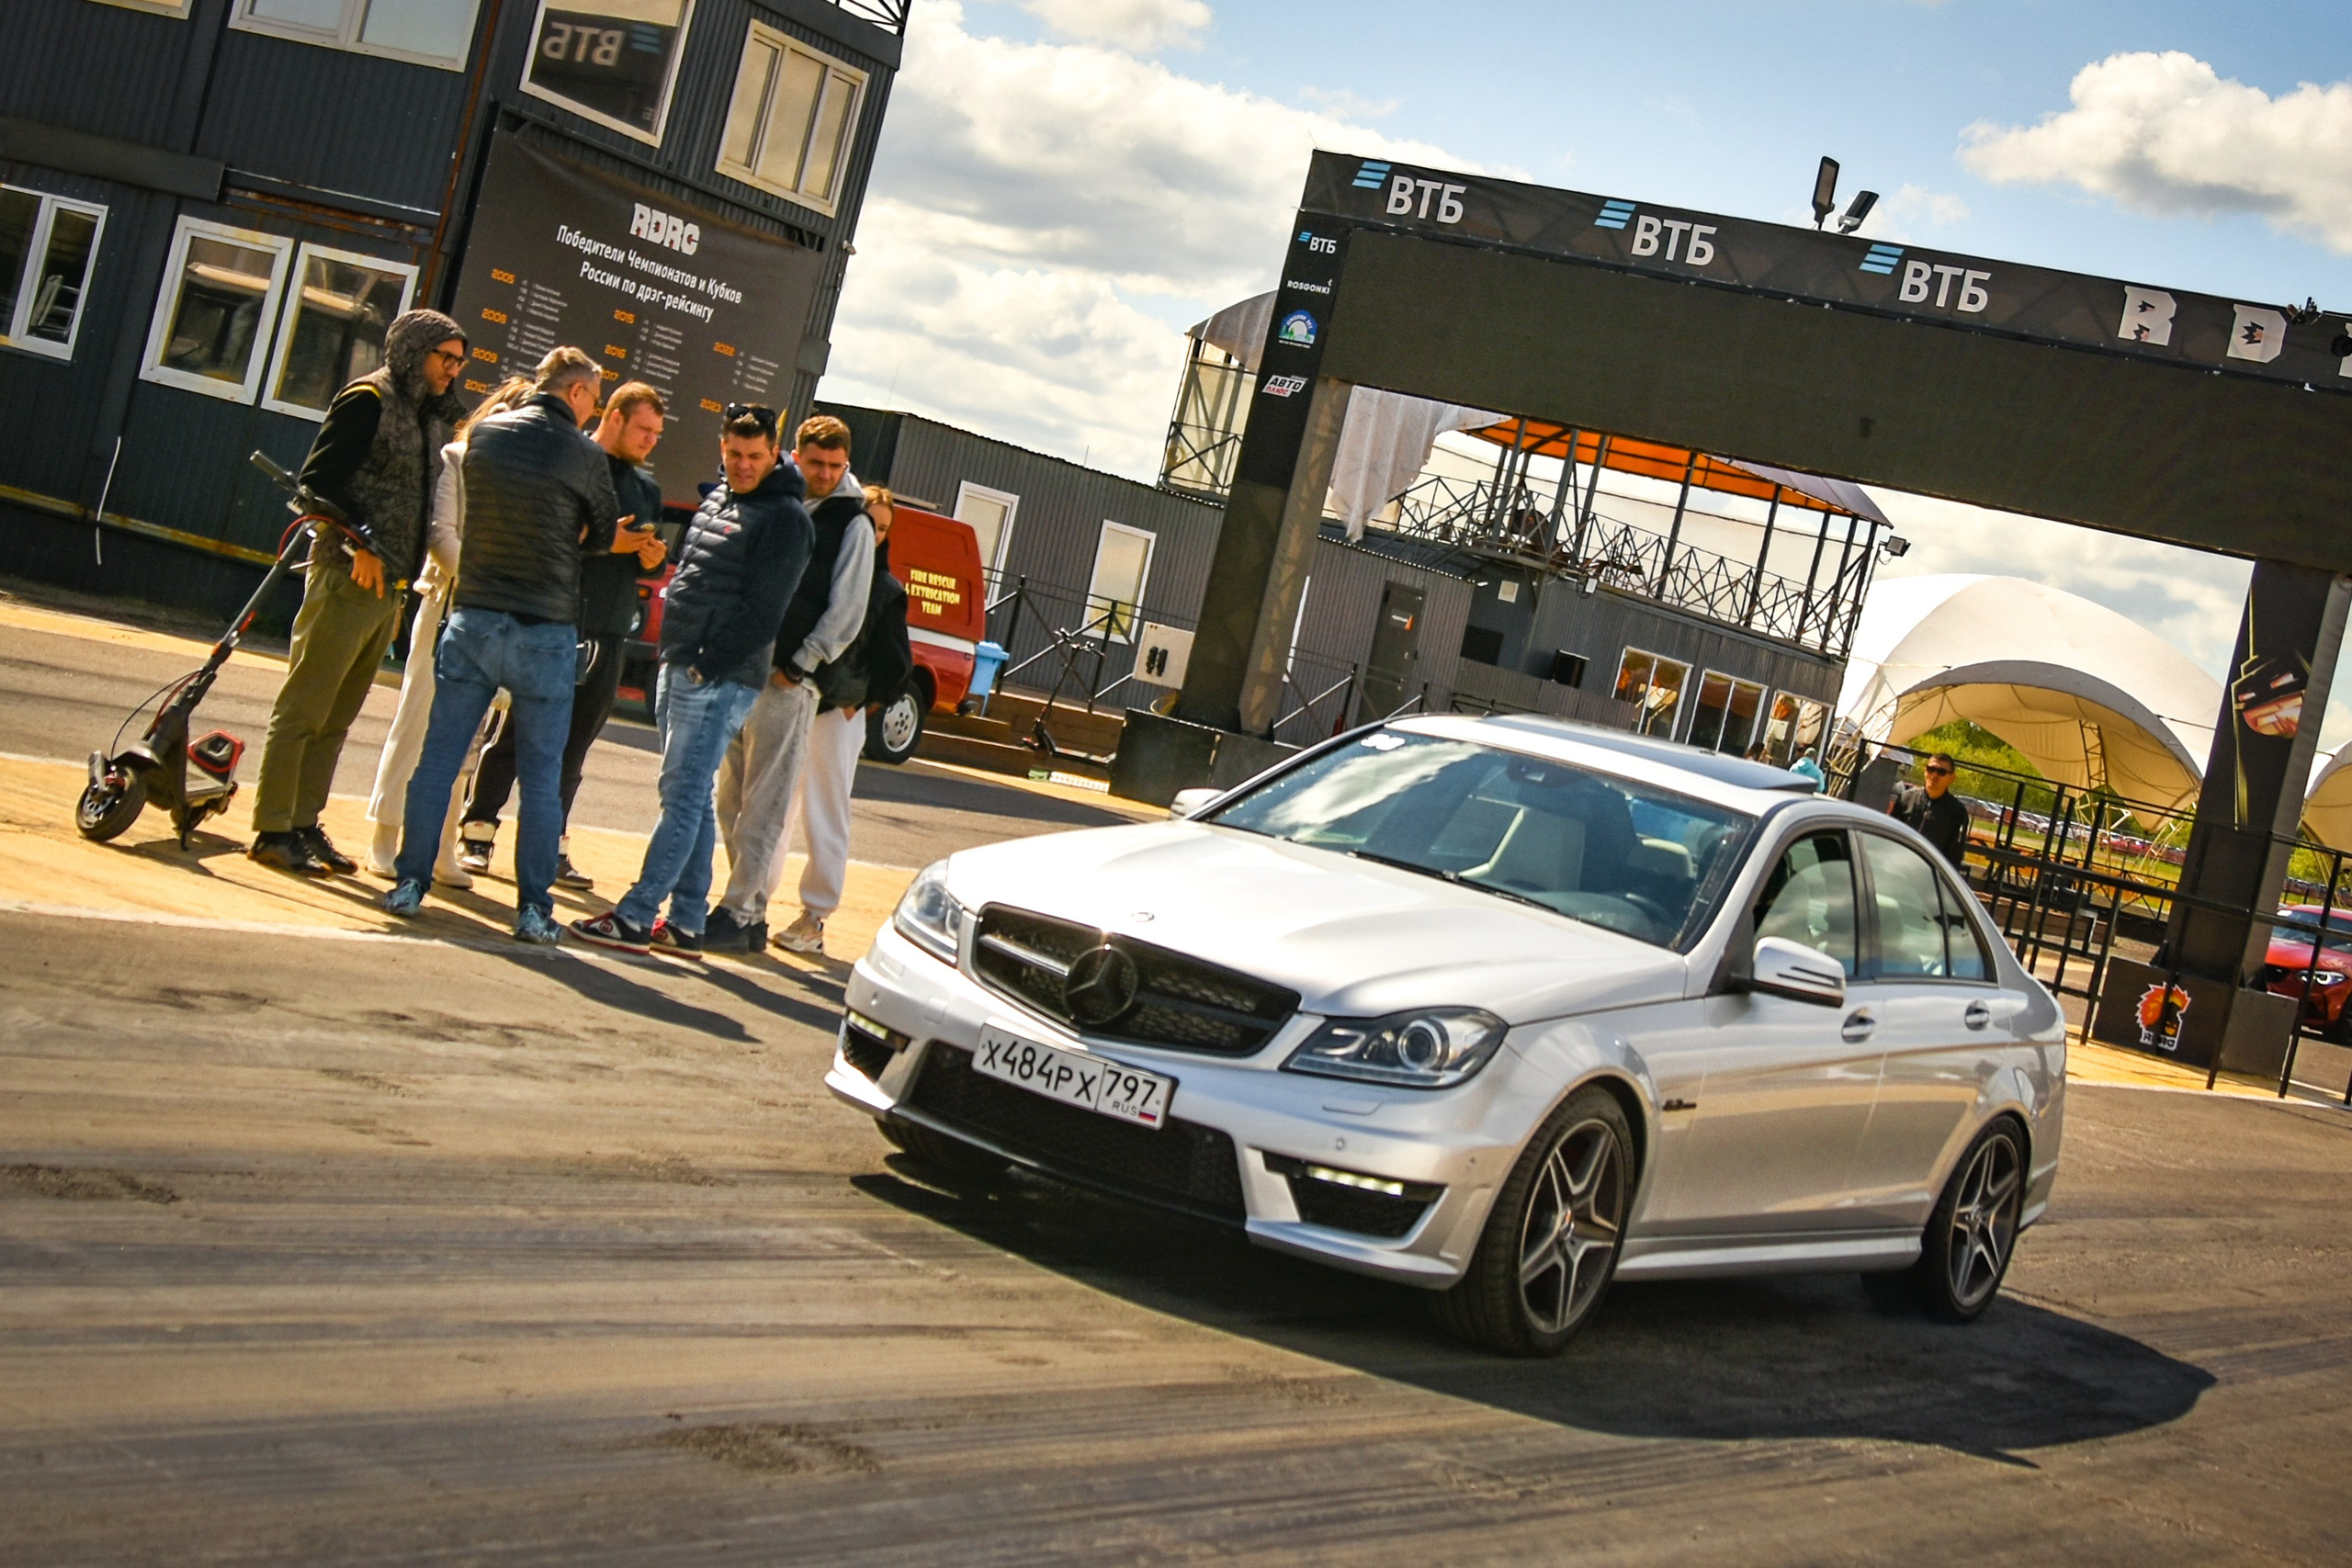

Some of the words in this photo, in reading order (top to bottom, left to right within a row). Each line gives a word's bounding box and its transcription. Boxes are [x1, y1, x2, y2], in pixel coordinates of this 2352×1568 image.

[1385, 175, 1466, 224] ВТБ
[629, 202, 700, 255] RDRC
[1309, 236, 1337, 254] ВТБ
[1631, 215, 1717, 266] ВТБ
[556, 224, 626, 264] Победители
[628, 249, 697, 289] Чемпионатов
[698, 277, 706, 291] и
[707, 277, 742, 304] Кубков
[491, 268, 516, 285] 2005
[1898, 259, 1992, 313] ВТБ
[580, 261, 620, 289] России
[622, 278, 636, 295] по
[636, 285, 715, 323] дрэг-рейсингу
[1286, 279, 1331, 295] ROSGONKI
[471, 347, 498, 364] 2009
[1269, 378, 1302, 390] АВТО
[700, 398, 722, 413] 2023
[910, 569, 927, 584] FIRE
[928, 572, 956, 590] RESCUE
[910, 584, 960, 605] EXTRICATION
[922, 601, 943, 616] TEAM
[2143, 1032, 2176, 1047] RRC
[1105, 1069, 1158, 1108] 797
[1112, 1100, 1137, 1117] RUS
